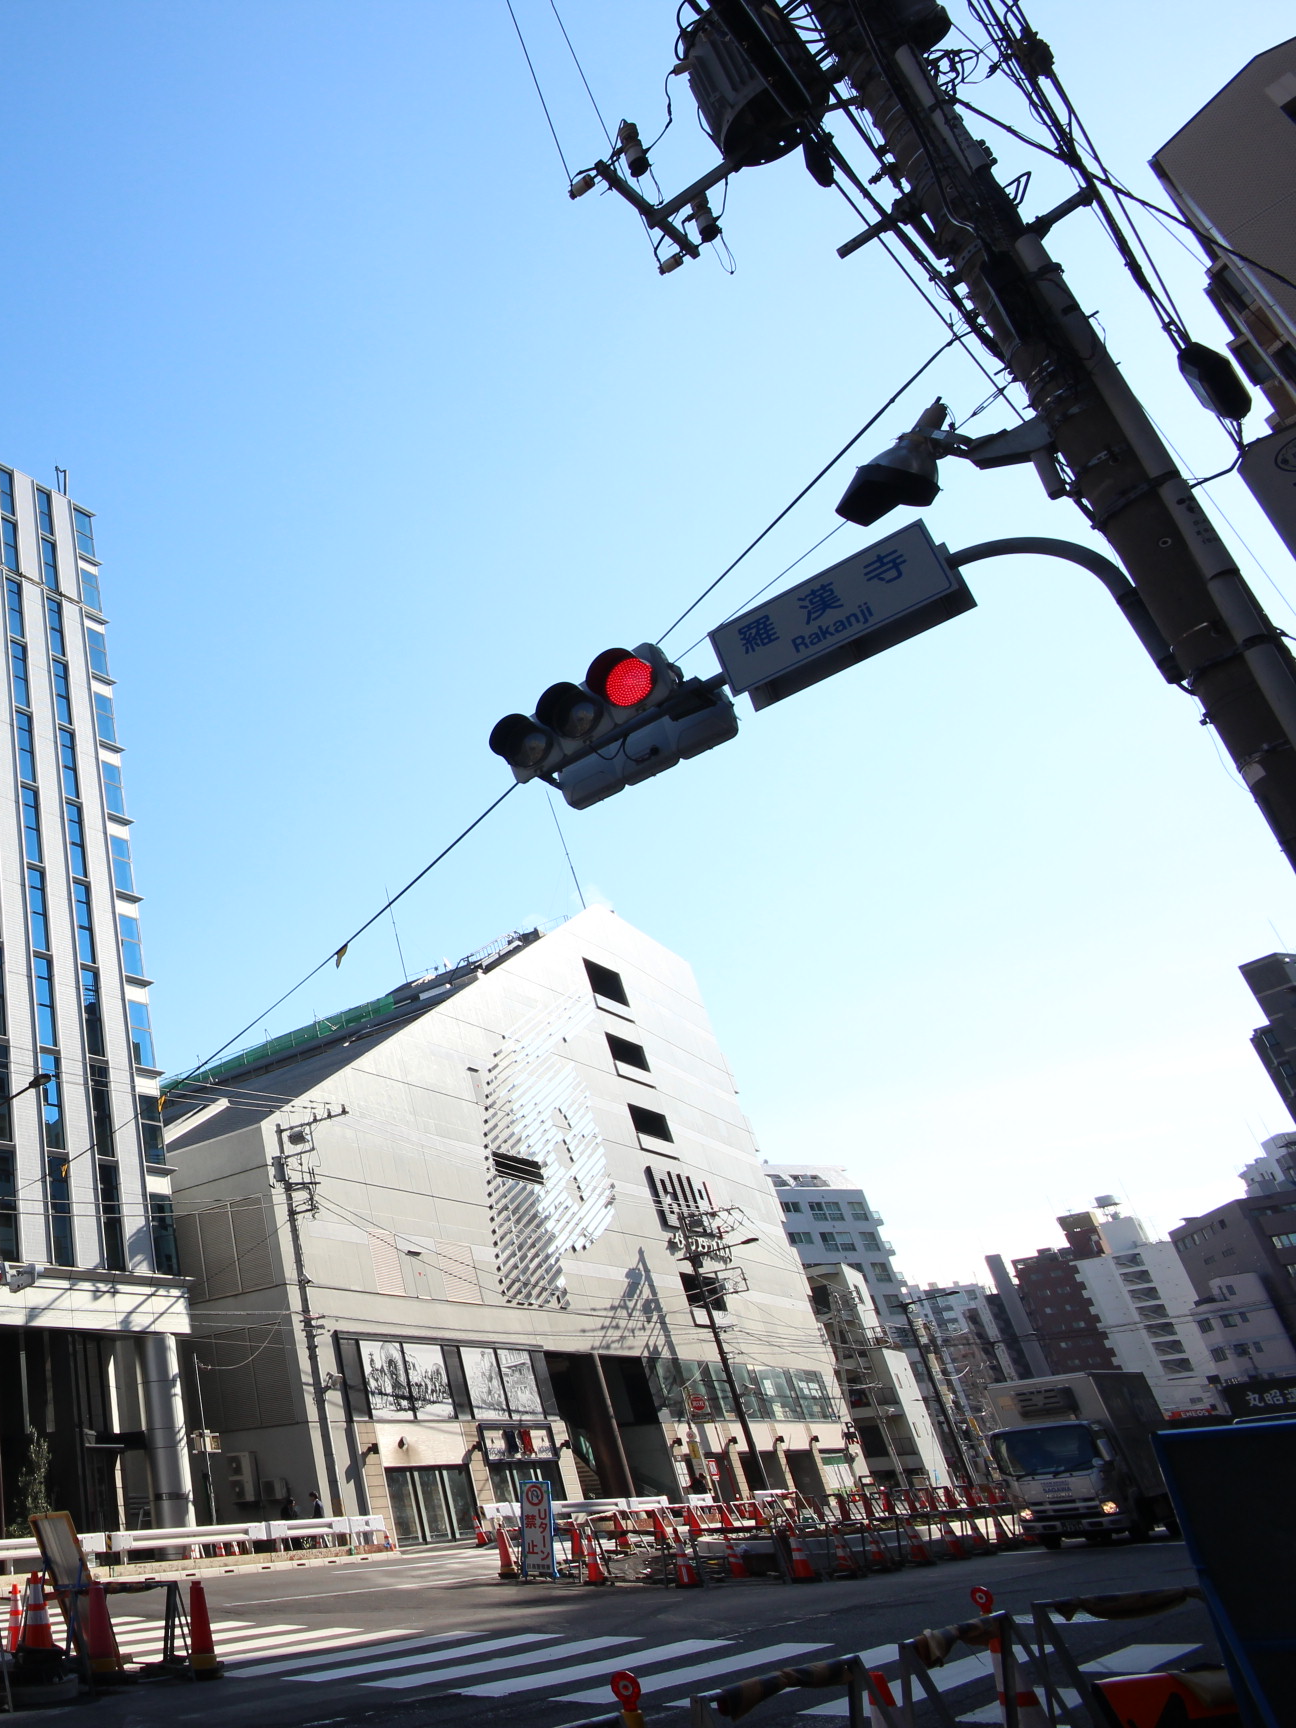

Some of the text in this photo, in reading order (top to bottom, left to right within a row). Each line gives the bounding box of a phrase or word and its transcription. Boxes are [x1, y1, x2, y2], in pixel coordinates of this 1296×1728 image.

[737, 549, 907, 655] 羅漢寺
[791, 601, 874, 653] Rakanji
[1181, 1409, 1209, 1418] ENEOS
[524, 1513, 539, 1555] 禁止
[538, 1508, 550, 1561] Uターン
